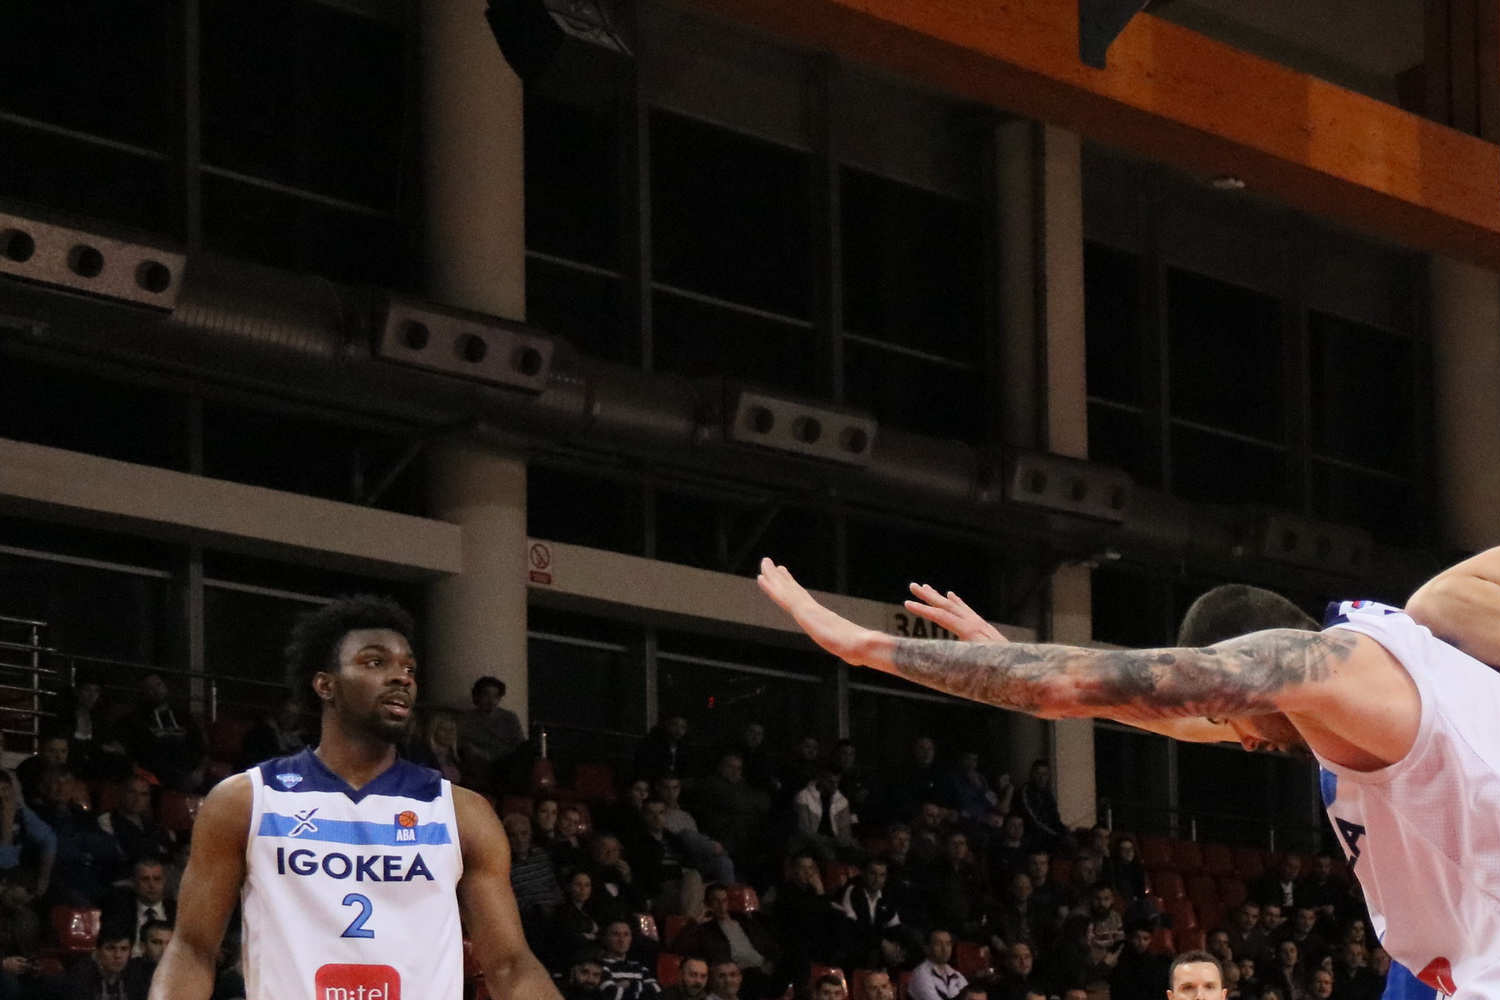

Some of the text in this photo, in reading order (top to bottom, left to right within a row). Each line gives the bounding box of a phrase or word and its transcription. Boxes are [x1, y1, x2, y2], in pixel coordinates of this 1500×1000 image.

[396, 828, 416, 842] ABA
[277, 847, 434, 882] IGOKEA
[340, 893, 375, 939] 2
